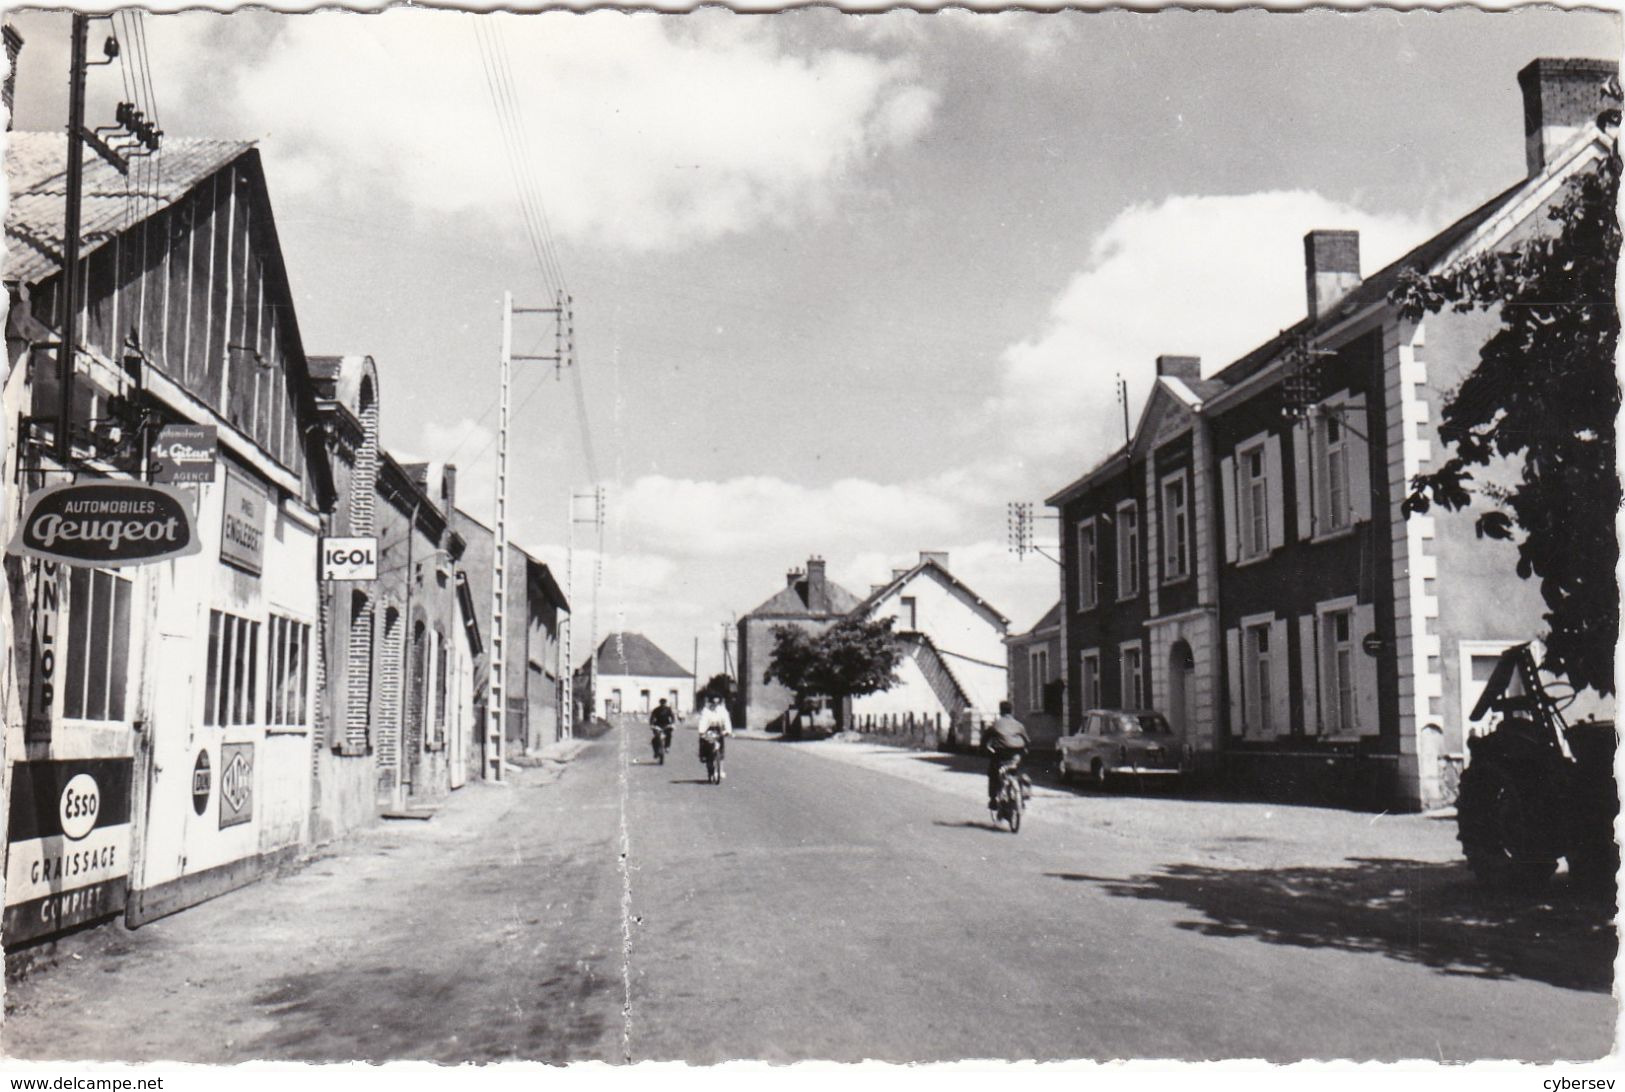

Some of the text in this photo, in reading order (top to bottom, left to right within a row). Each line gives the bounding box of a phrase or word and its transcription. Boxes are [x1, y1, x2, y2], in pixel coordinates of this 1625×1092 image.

[173, 472, 209, 481] AGENCE
[64, 500, 156, 514] AUTOMOBILES
[32, 513, 179, 551] Peugeot
[326, 549, 374, 565] IGOL
[31, 845, 116, 885] GRAISSAGE
[40, 886, 103, 923] COMPLET
